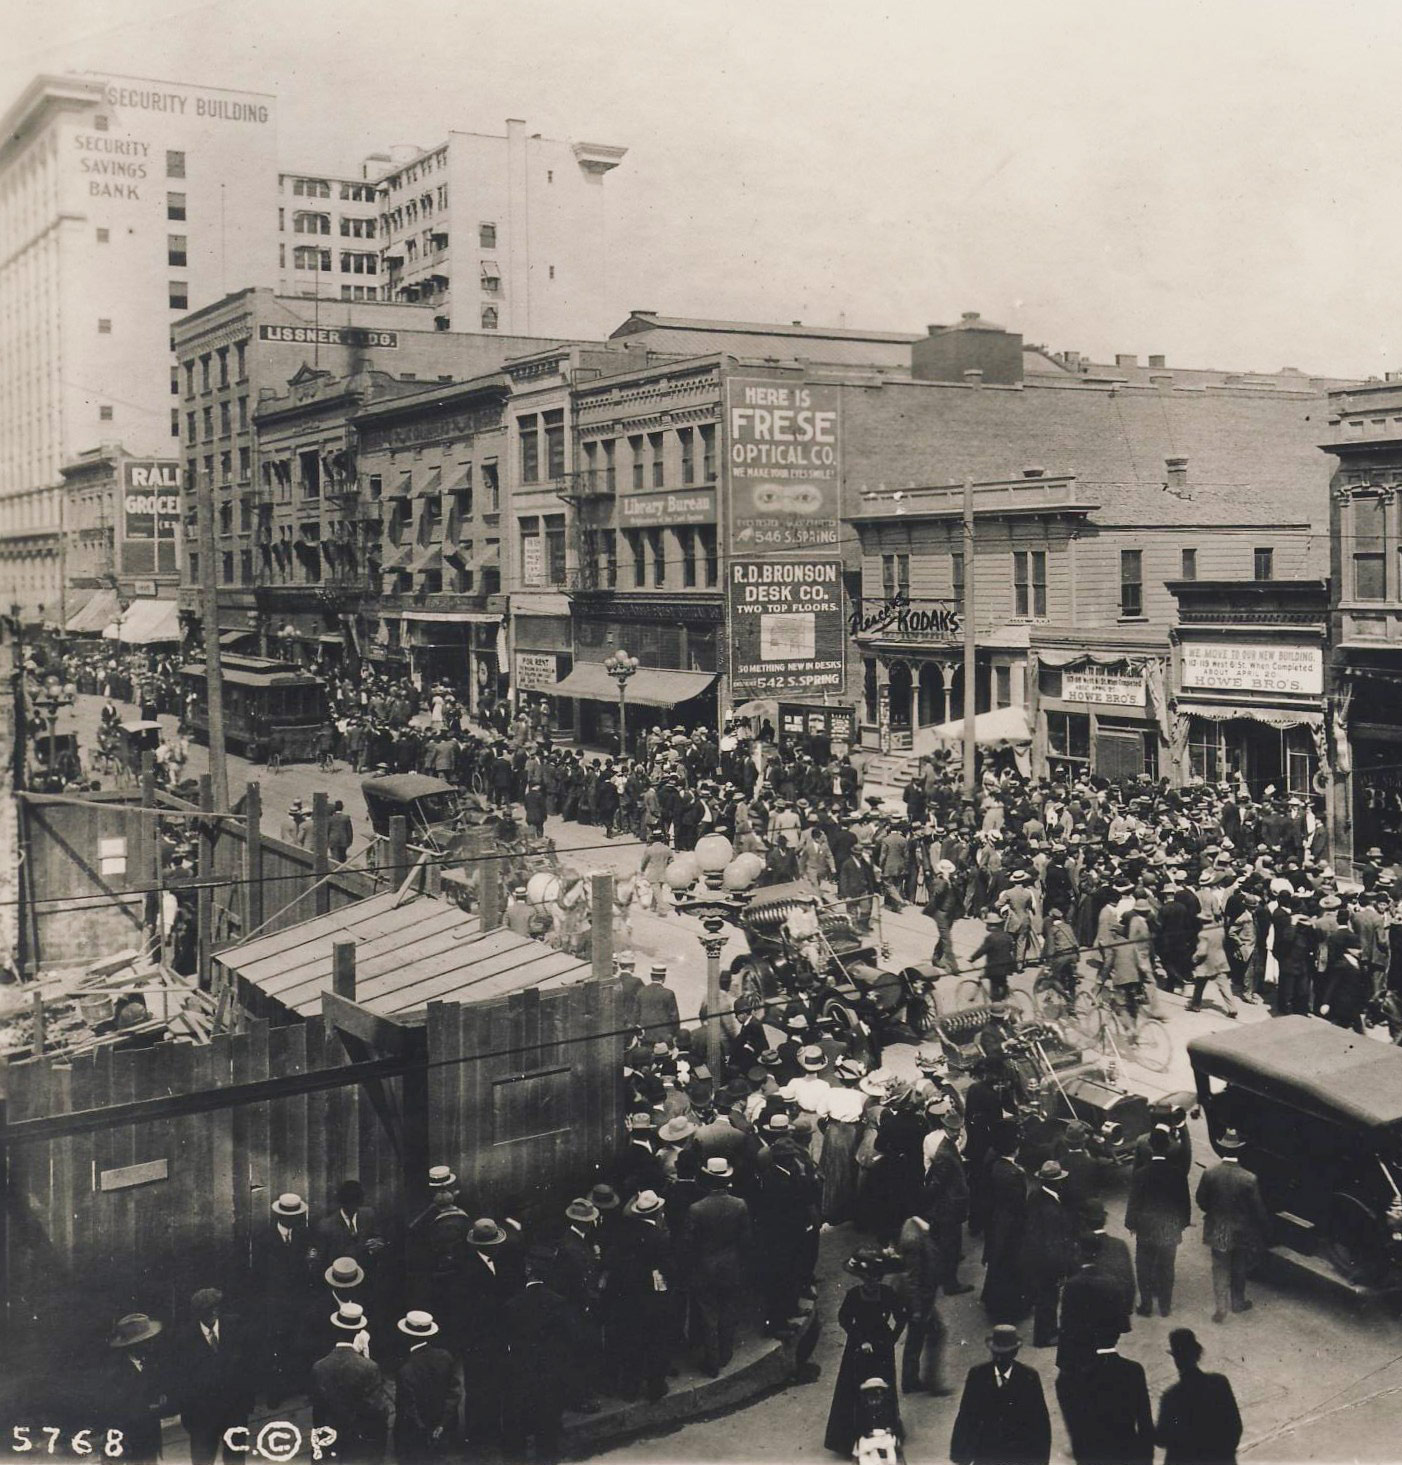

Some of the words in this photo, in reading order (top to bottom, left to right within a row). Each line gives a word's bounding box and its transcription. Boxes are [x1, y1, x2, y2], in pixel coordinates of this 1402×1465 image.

[107, 86, 188, 115] SECURITY
[196, 98, 269, 124] BUILDING
[74, 135, 150, 157] SECURITY
[80, 157, 147, 179] SAVINGS
[89, 180, 140, 200] BANK
[267, 326, 341, 343] LISSNER
[745, 387, 789, 406] HERE
[795, 389, 811, 408] IS
[732, 408, 837, 443] FRESE
[732, 444, 808, 465] OPTICAL
[811, 446, 837, 466] CO.
[624, 498, 665, 516] Library
[667, 496, 710, 512] Bureau
[755, 531, 782, 543] 546
[745, 586, 792, 601] DESK
[800, 585, 829, 600] CO.
[737, 605, 762, 613] TWO
[768, 604, 788, 613] TOP
[898, 609, 960, 633] KODAKS
[1204, 649, 1228, 659] MOVE
[1260, 651, 1275, 660] NEW
[738, 664, 785, 673] SOMETHING
[788, 662, 804, 671] NEW
[805, 662, 813, 670] IN
[815, 661, 841, 669] DESKS
[1250, 661, 1270, 670] When
[1272, 661, 1314, 672] Completed
[757, 676, 785, 688] 542
[1195, 676, 1243, 688] HOWE
[1069, 691, 1103, 701] HOWE
